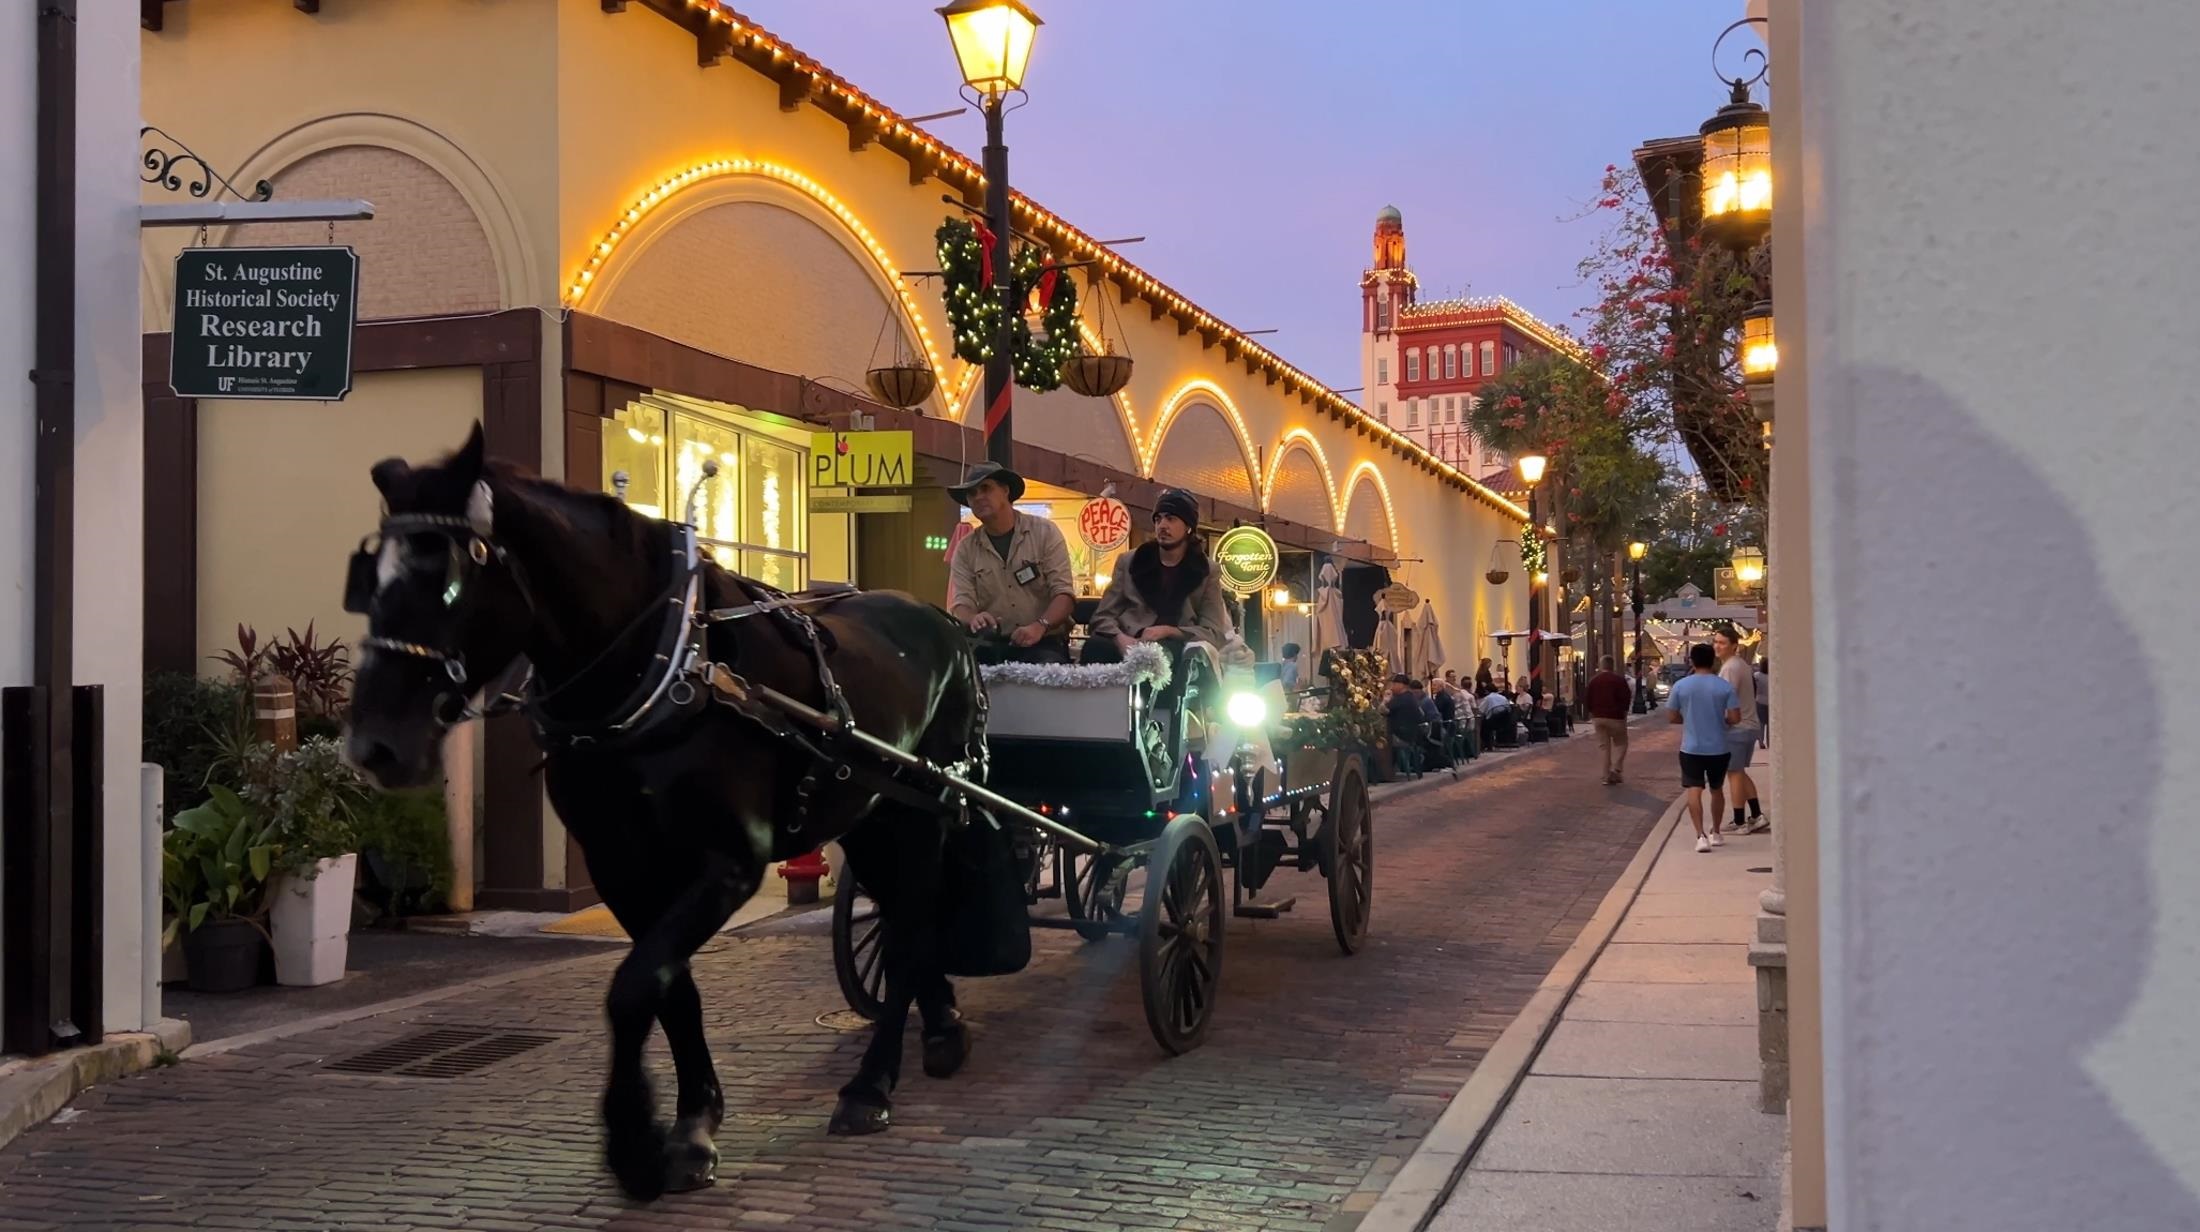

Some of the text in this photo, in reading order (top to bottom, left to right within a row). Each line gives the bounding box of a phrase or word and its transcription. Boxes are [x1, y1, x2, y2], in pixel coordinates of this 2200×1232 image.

[205, 262, 323, 285] St. Augustine
[186, 288, 340, 312] Historical Society
[200, 314, 322, 337] Research
[207, 344, 312, 375] Library
[218, 376, 236, 392] UF
[816, 432, 906, 487] PLUM
[1082, 498, 1129, 533] PEACE
[1090, 525, 1120, 544] PIE
[1217, 551, 1273, 565] Forgotten
[1240, 561, 1270, 572] Tonic
